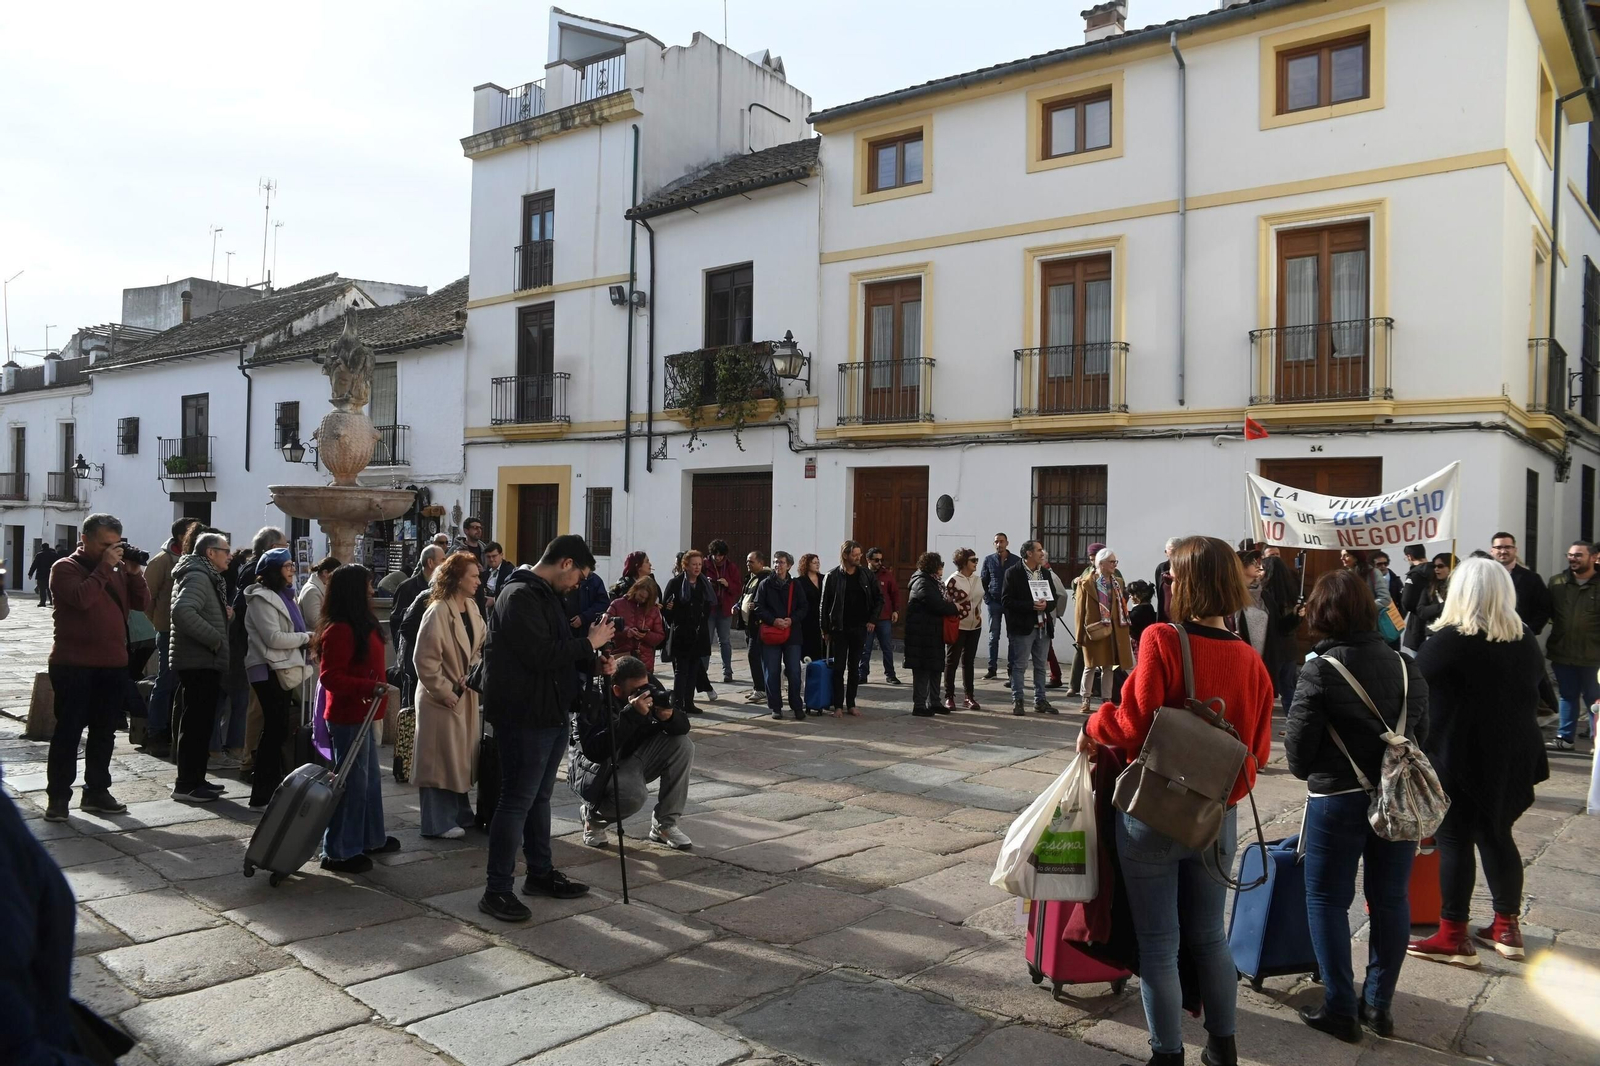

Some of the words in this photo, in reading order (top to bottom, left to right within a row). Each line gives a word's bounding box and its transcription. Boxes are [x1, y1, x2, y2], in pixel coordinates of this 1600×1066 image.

[1273, 486, 1299, 501] LA
[1260, 495, 1285, 518] ES
[1297, 512, 1316, 525] un
[1333, 489, 1444, 526] DERECHO
[1261, 520, 1286, 541] NO
[1303, 533, 1322, 546] un
